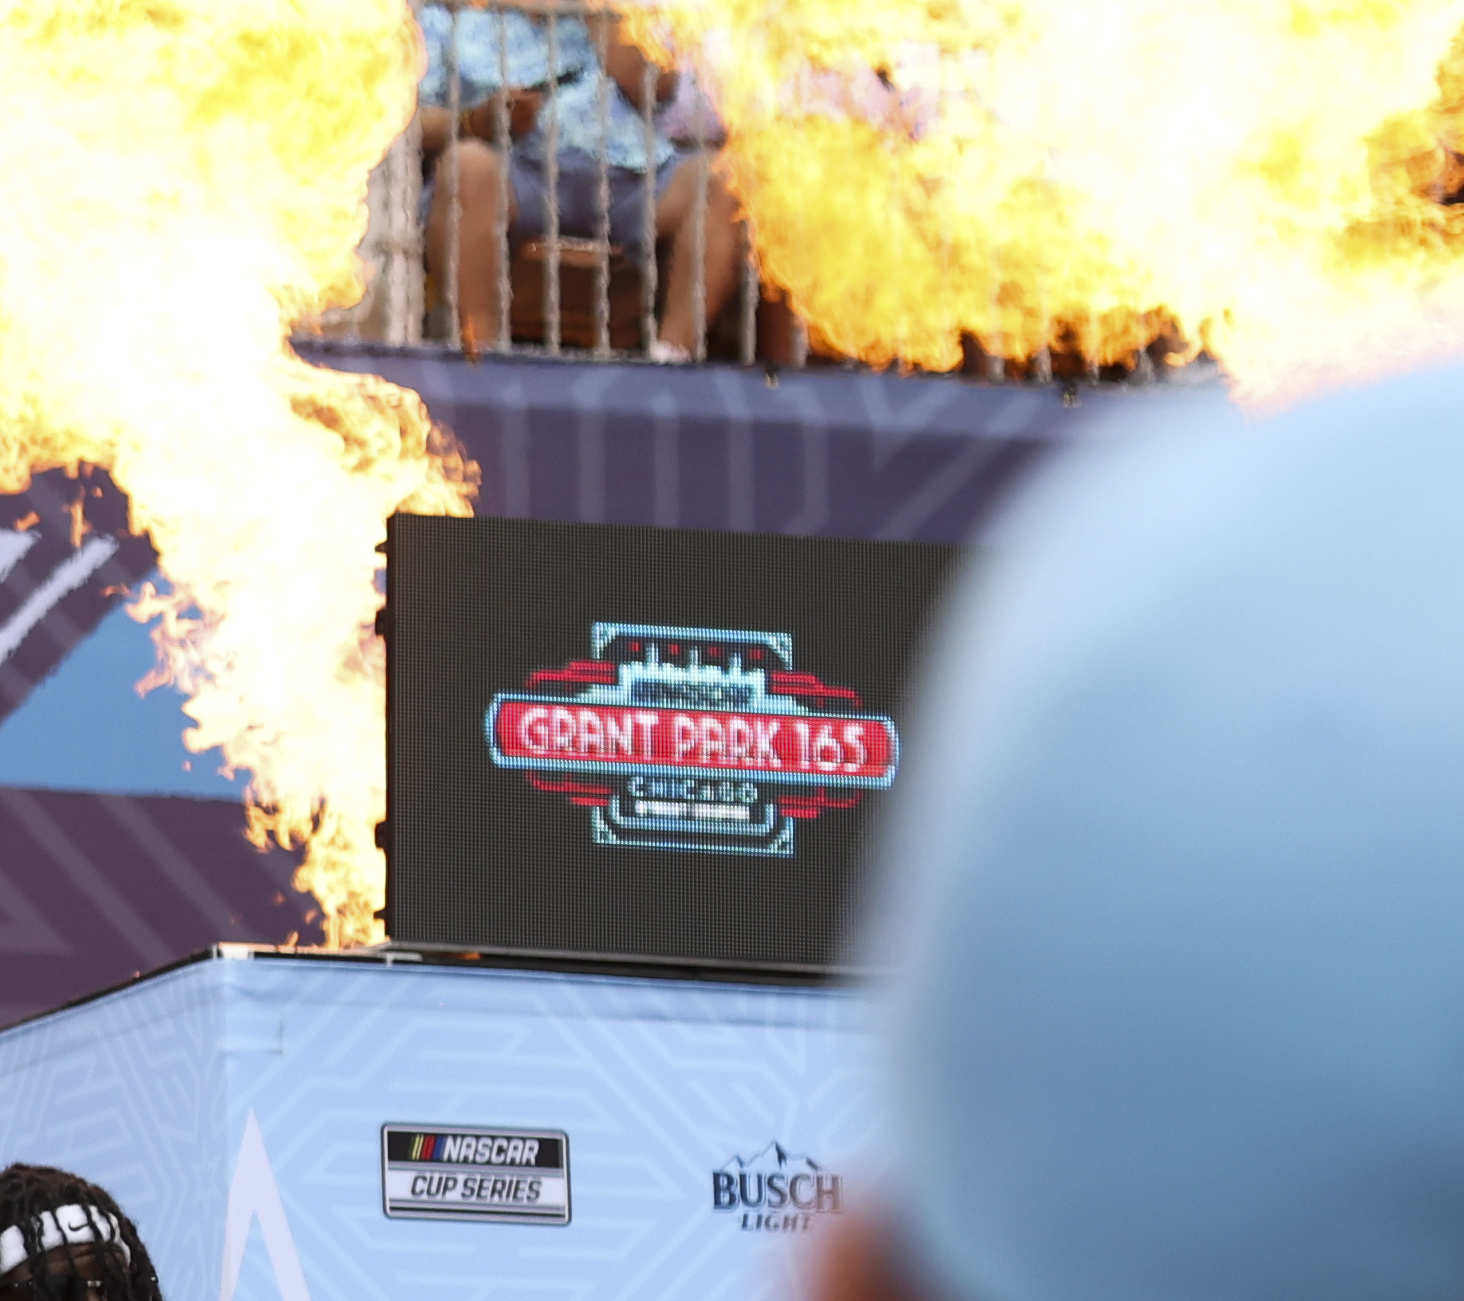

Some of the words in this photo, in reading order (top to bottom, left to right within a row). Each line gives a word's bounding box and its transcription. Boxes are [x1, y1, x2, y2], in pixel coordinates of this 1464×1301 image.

[519, 706, 659, 766] GRANT
[674, 712, 782, 768] PARK
[795, 720, 869, 774] 165
[626, 775, 759, 804] CHICAGO
[442, 1134, 540, 1166] NASCAR
[410, 1174, 459, 1198] CUP
[460, 1176, 543, 1203] SERIES
[712, 1170, 844, 1214] BUSCH
[740, 1212, 813, 1232] LIGHT
